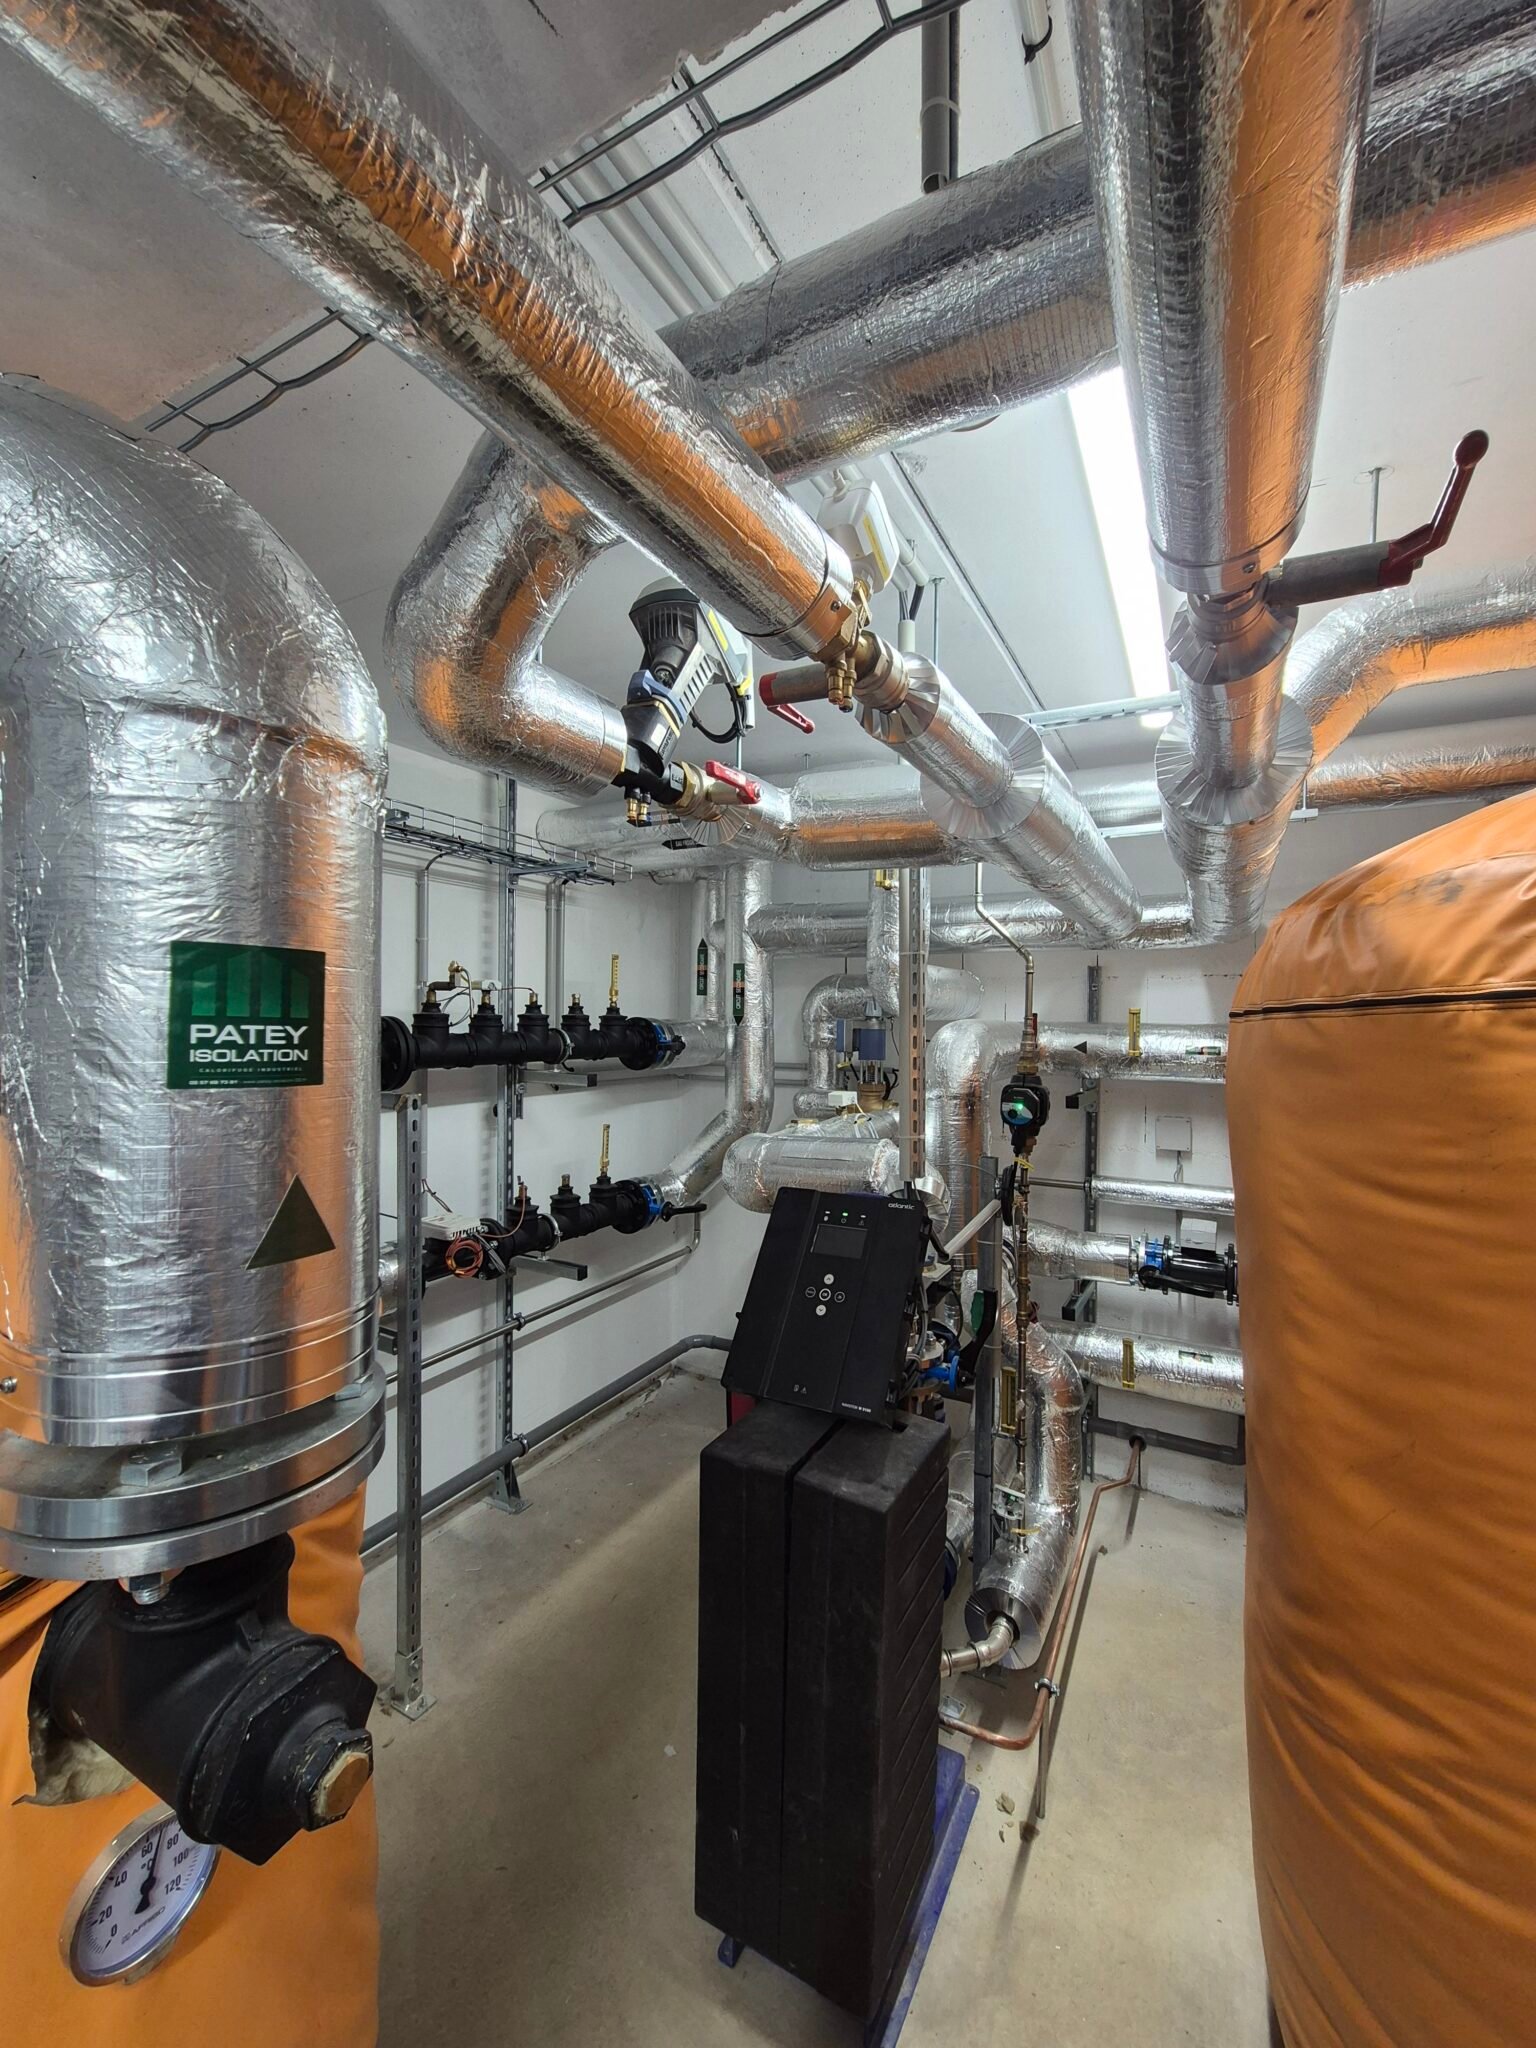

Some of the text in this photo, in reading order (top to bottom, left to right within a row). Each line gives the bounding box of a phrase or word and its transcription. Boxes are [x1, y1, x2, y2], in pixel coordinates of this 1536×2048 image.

[190, 1024, 308, 1044] PATEY
[190, 1049, 308, 1062] ISOLATION
[887, 1202, 915, 1210] atlantic
[141, 1841, 153, 1858] 60
[166, 1833, 179, 1850] 80
[173, 1849, 190, 1868] 100
[114, 1871, 127, 1887] 40
[165, 1874, 181, 1894] 120
[98, 1905, 113, 1924] 20
[110, 1923, 118, 1937] 0
